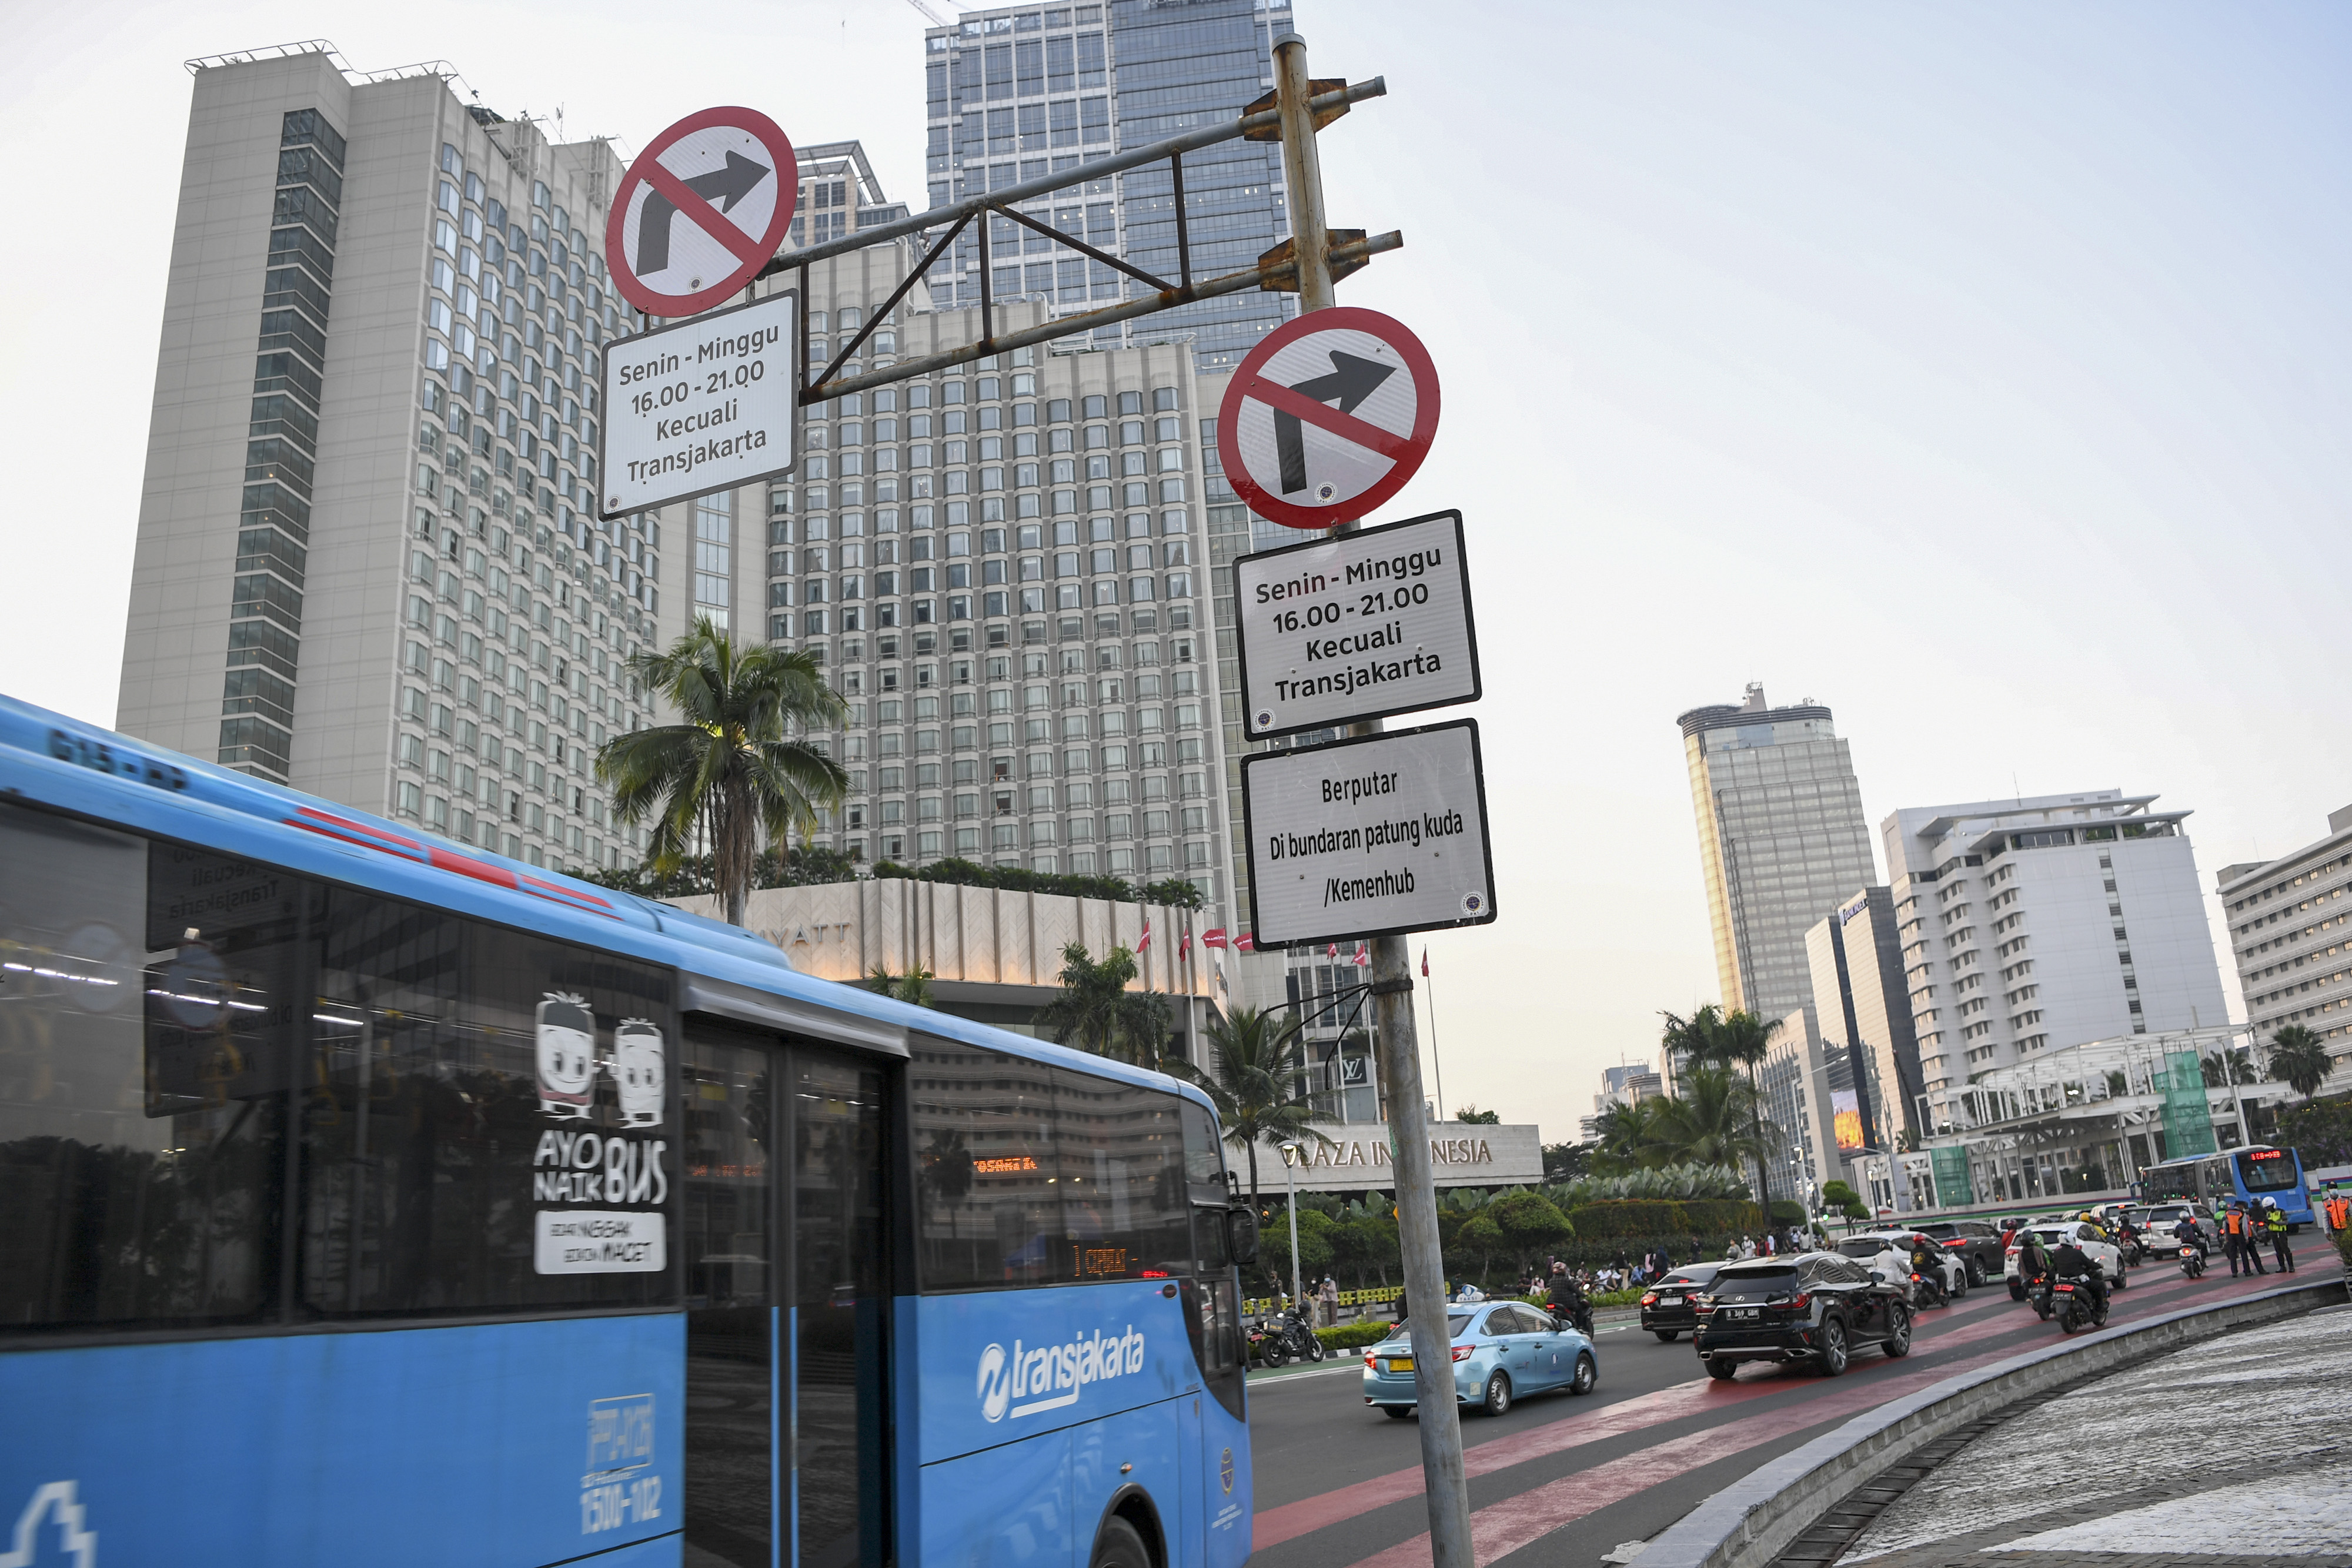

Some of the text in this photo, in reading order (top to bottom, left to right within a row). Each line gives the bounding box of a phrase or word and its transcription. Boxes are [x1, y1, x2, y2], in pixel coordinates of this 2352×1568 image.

[619, 353, 680, 386] Senin
[698, 325, 779, 364] Minggu
[632, 382, 689, 414] 16.00
[706, 360, 764, 394] 21.00
[656, 398, 738, 441] Kecuali
[627, 429, 767, 482] Transjakarta
[1256, 573, 1326, 604] Senin
[1346, 549, 1441, 586] Minggu
[1273, 603, 1341, 634] 16.00
[1360, 583, 1429, 616] 21.00
[1306, 621, 1402, 661] Kecuali
[1275, 653, 1441, 701] Transjakarta
[1322, 771, 1398, 805] Berputar
[1269, 809, 1464, 860] Di bundaran patung kuda
[1324, 867, 1415, 908] /Kemenhub
[533, 1129, 602, 1169] AYO
[533, 1136, 667, 1204] NAIK BUS
[1371, 1139, 1492, 1166] INNESIA
[1012, 1324, 1145, 1406] transjakarta
